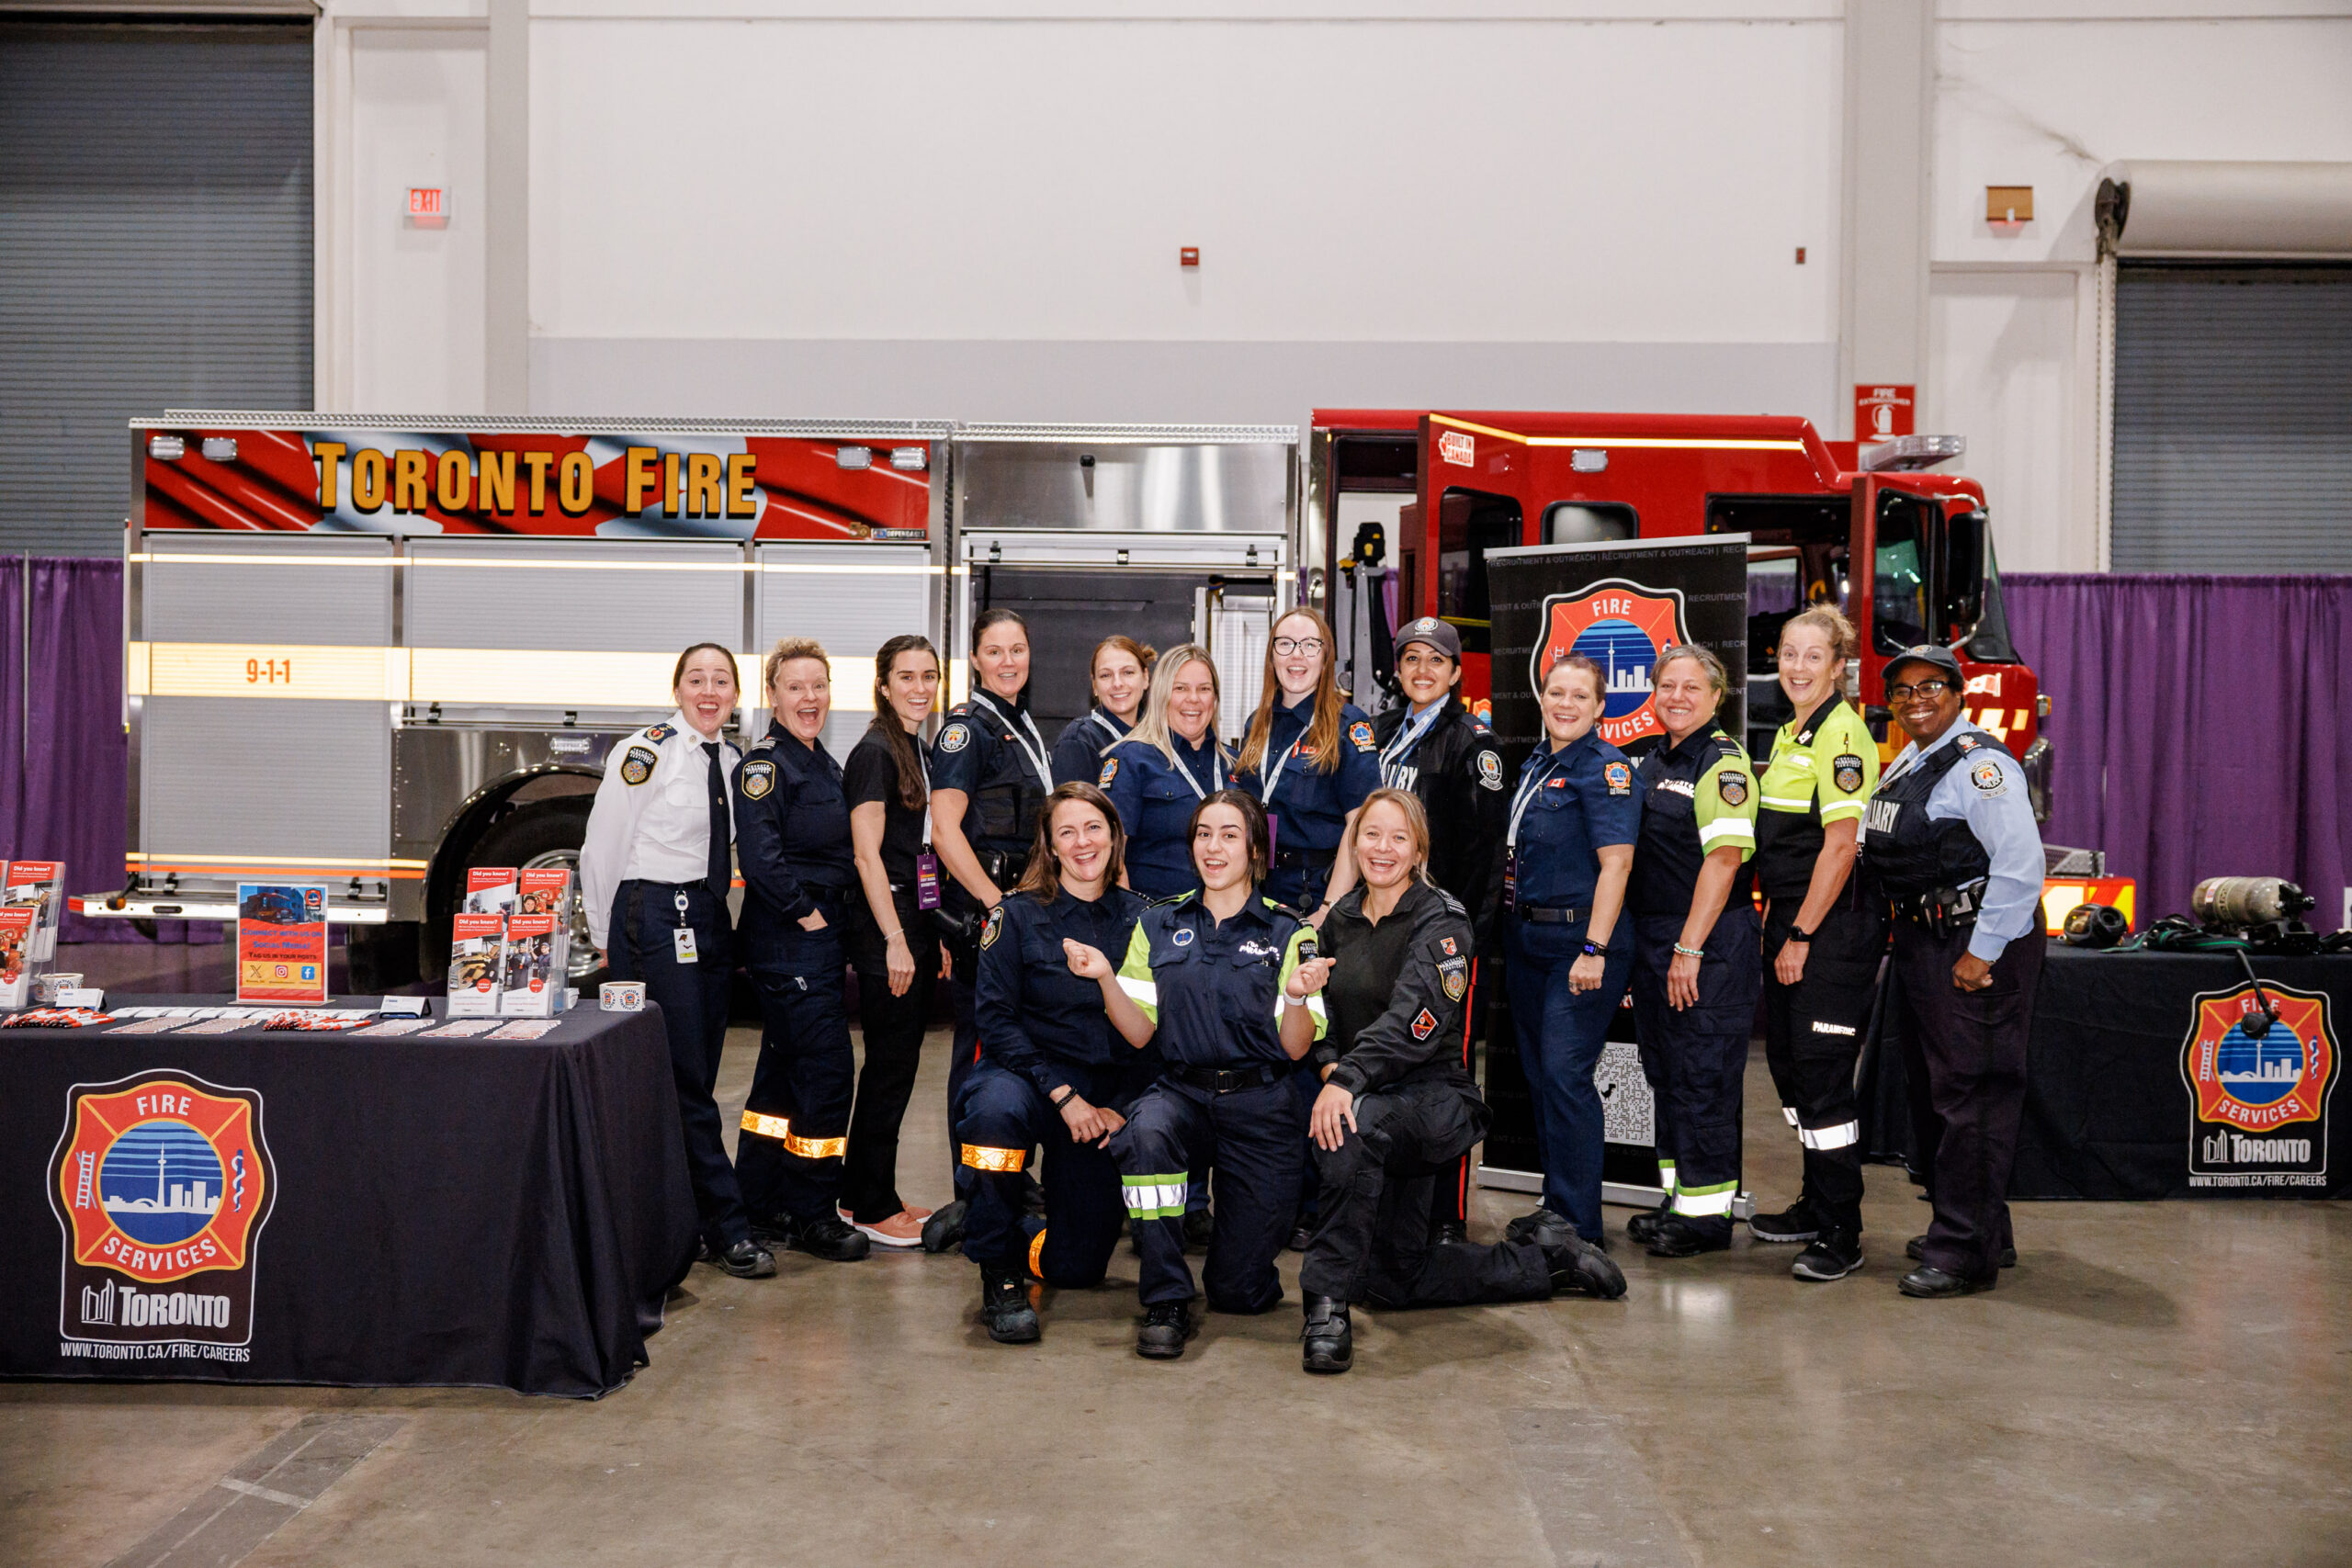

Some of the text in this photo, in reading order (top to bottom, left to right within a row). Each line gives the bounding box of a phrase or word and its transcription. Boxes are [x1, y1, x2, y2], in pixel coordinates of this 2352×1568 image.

[410, 188, 441, 213] EXIT
[1873, 388, 1896, 398] FIRE
[1446, 434, 1464, 448] BUILT
[1446, 447, 1472, 464] CANADA
[313, 441, 757, 520] TORONTO FIRE
[1490, 557, 1544, 568] RECRUITMENT
[1552, 553, 1596, 564] OUTREACH
[1602, 551, 1659, 561] RECRUITMENT
[1668, 547, 1714, 557] OUTREACH
[1592, 598, 1632, 617] FIRE
[1688, 593, 1747, 602] RECRUITMENT
[246, 659, 290, 684] 9-1-1
[1594, 711, 1654, 739] RVICES
[1866, 799, 1900, 833] LIARY
[241, 928, 277, 936] CONNECT
[2240, 998, 2280, 1014] FIE
[1812, 1021, 1856, 1036] PARAMEDIC
[136, 1094, 192, 1116] FIRE
[2219, 1099, 2300, 1124] SERVICES
[2230, 1134, 2311, 1163] TORONTO
[2189, 1175, 2327, 1187] WWW.TORONTO.CA/FIRE/CAREERS
[103, 1237, 217, 1271] SERVICES
[119, 1286, 231, 1328] TORONTO
[61, 1342, 250, 1363] WWW.TORONTO.CA/FIRE/CAREERS
